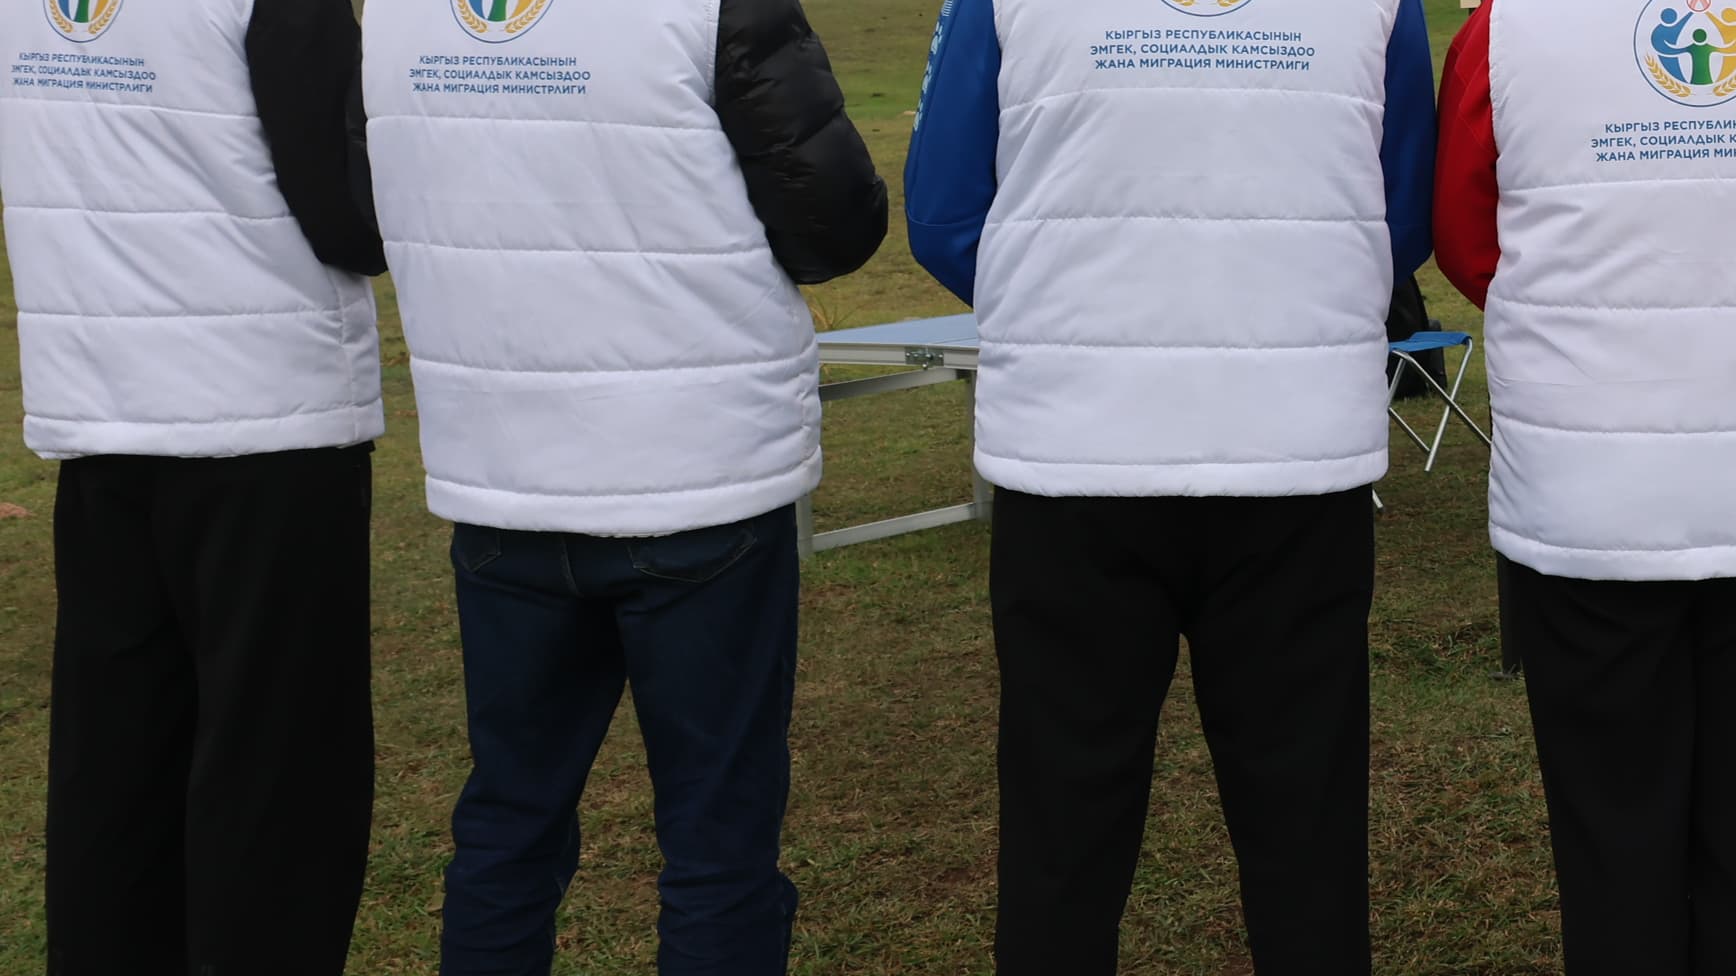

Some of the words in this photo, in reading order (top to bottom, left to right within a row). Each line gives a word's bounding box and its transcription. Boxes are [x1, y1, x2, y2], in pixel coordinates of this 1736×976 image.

[1106, 30, 1161, 40] КЫРГЫЗ
[1166, 30, 1301, 41] РЕСПУБЛИКАСЫНЫН
[1090, 44, 1137, 55] ЭМГЕК,
[1141, 44, 1228, 55] СОЦИАЛДЫК
[1232, 45, 1315, 57] КАМСЫЗДОО
[420, 55, 459, 65] КЫРГЫЗ
[463, 56, 576, 66] РЕСПУБЛИКАСЫНЫН
[1095, 59, 1135, 69] ЖАНА
[1140, 59, 1211, 68] МИГРАЦИЯ
[1216, 59, 1309, 70] МИНИСТРЛИГИ
[94, 67, 156, 80] КАМСЫЗДОО
[409, 69, 441, 79] ЭМГЕК,
[444, 69, 512, 79] СОЦИАЛДЫК
[516, 71, 591, 80] КАМСЫЗДОО
[413, 83, 440, 92] ЖАНА
[444, 83, 499, 94] МИГРАЦИЯ
[502, 84, 585, 94] МИНИСТРЛИГИ
[1605, 122, 1660, 133] КЫРГЫЗ
[1591, 137, 1636, 148] ЭМГЕК,
[1640, 135, 1725, 146] СОЦИАЛДЫК
[1596, 152, 1635, 161] ЖАНА
[1640, 149, 1709, 160] МИГРАЦИЯ
